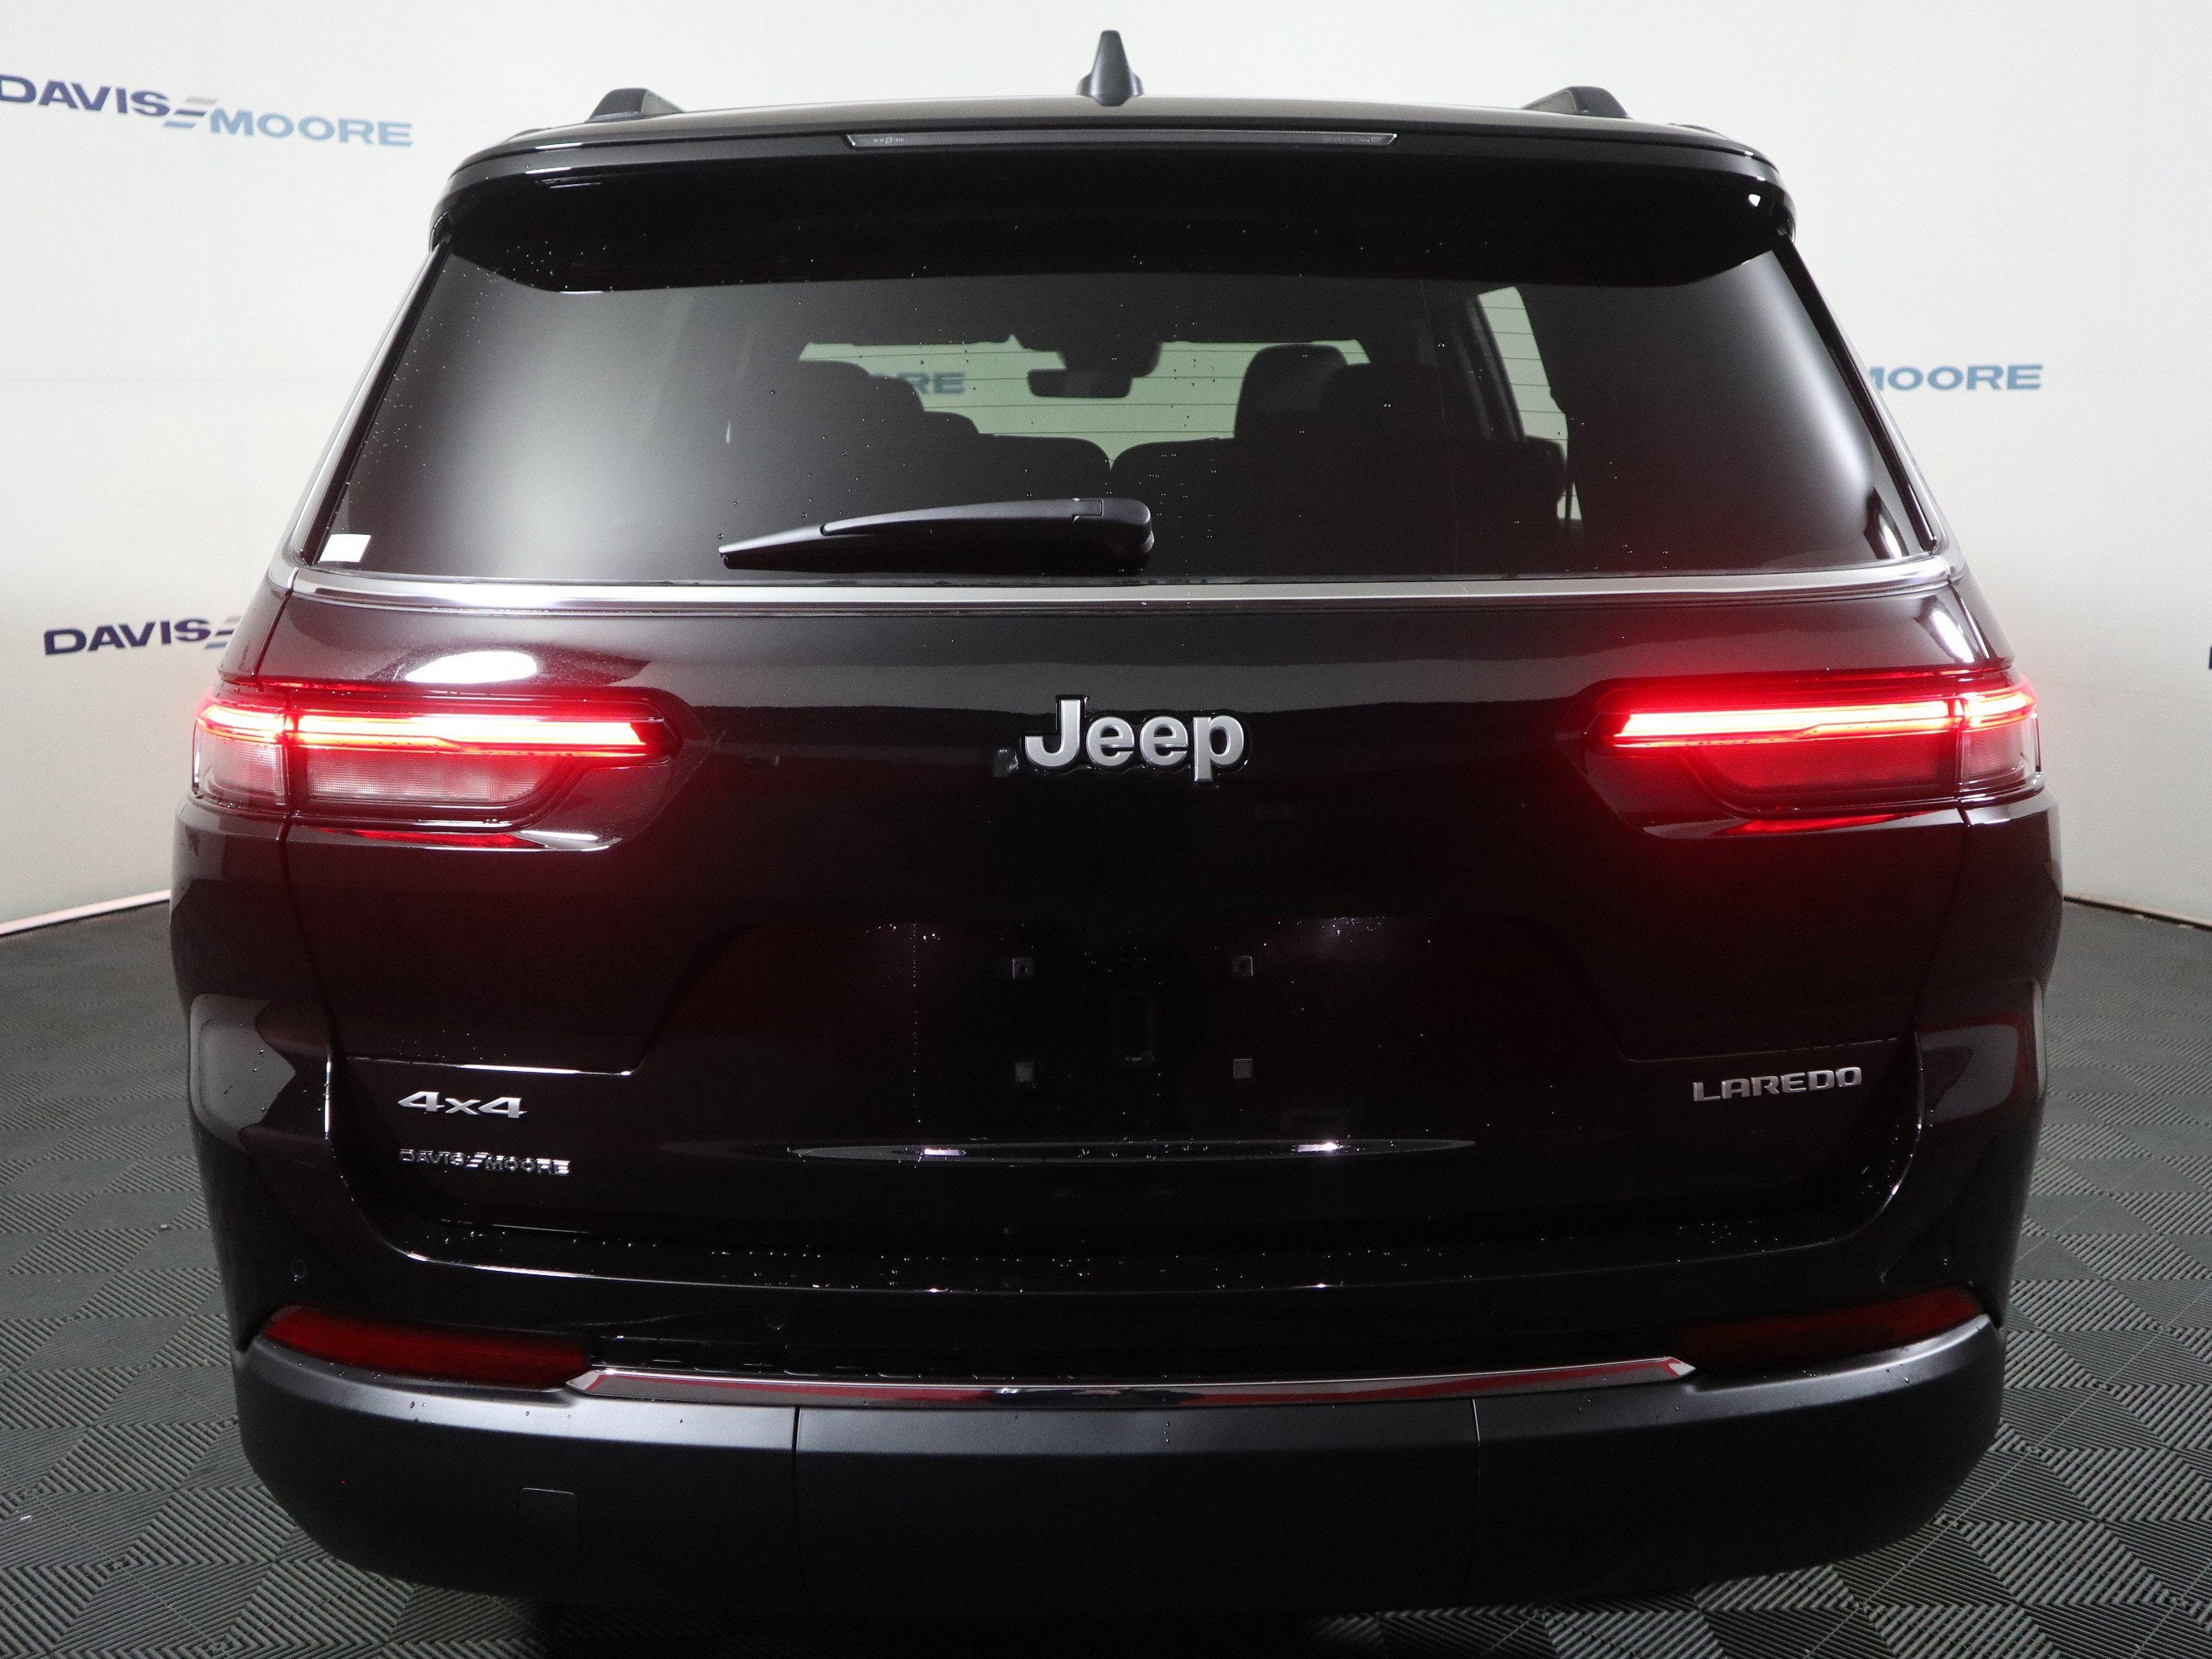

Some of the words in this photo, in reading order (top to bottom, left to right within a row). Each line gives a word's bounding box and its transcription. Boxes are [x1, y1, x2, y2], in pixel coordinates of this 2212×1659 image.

[0, 74, 170, 116] DAVIS
[210, 107, 413, 147] MOORE
[43, 618, 212, 655] DAVIS
[1024, 698, 1245, 782] Jeep
[1692, 1066, 1863, 1102] LAREDO
[397, 1091, 528, 1118] 4x4
[398, 1148, 466, 1166] DAVIS
[485, 1154, 570, 1177] MOORE
